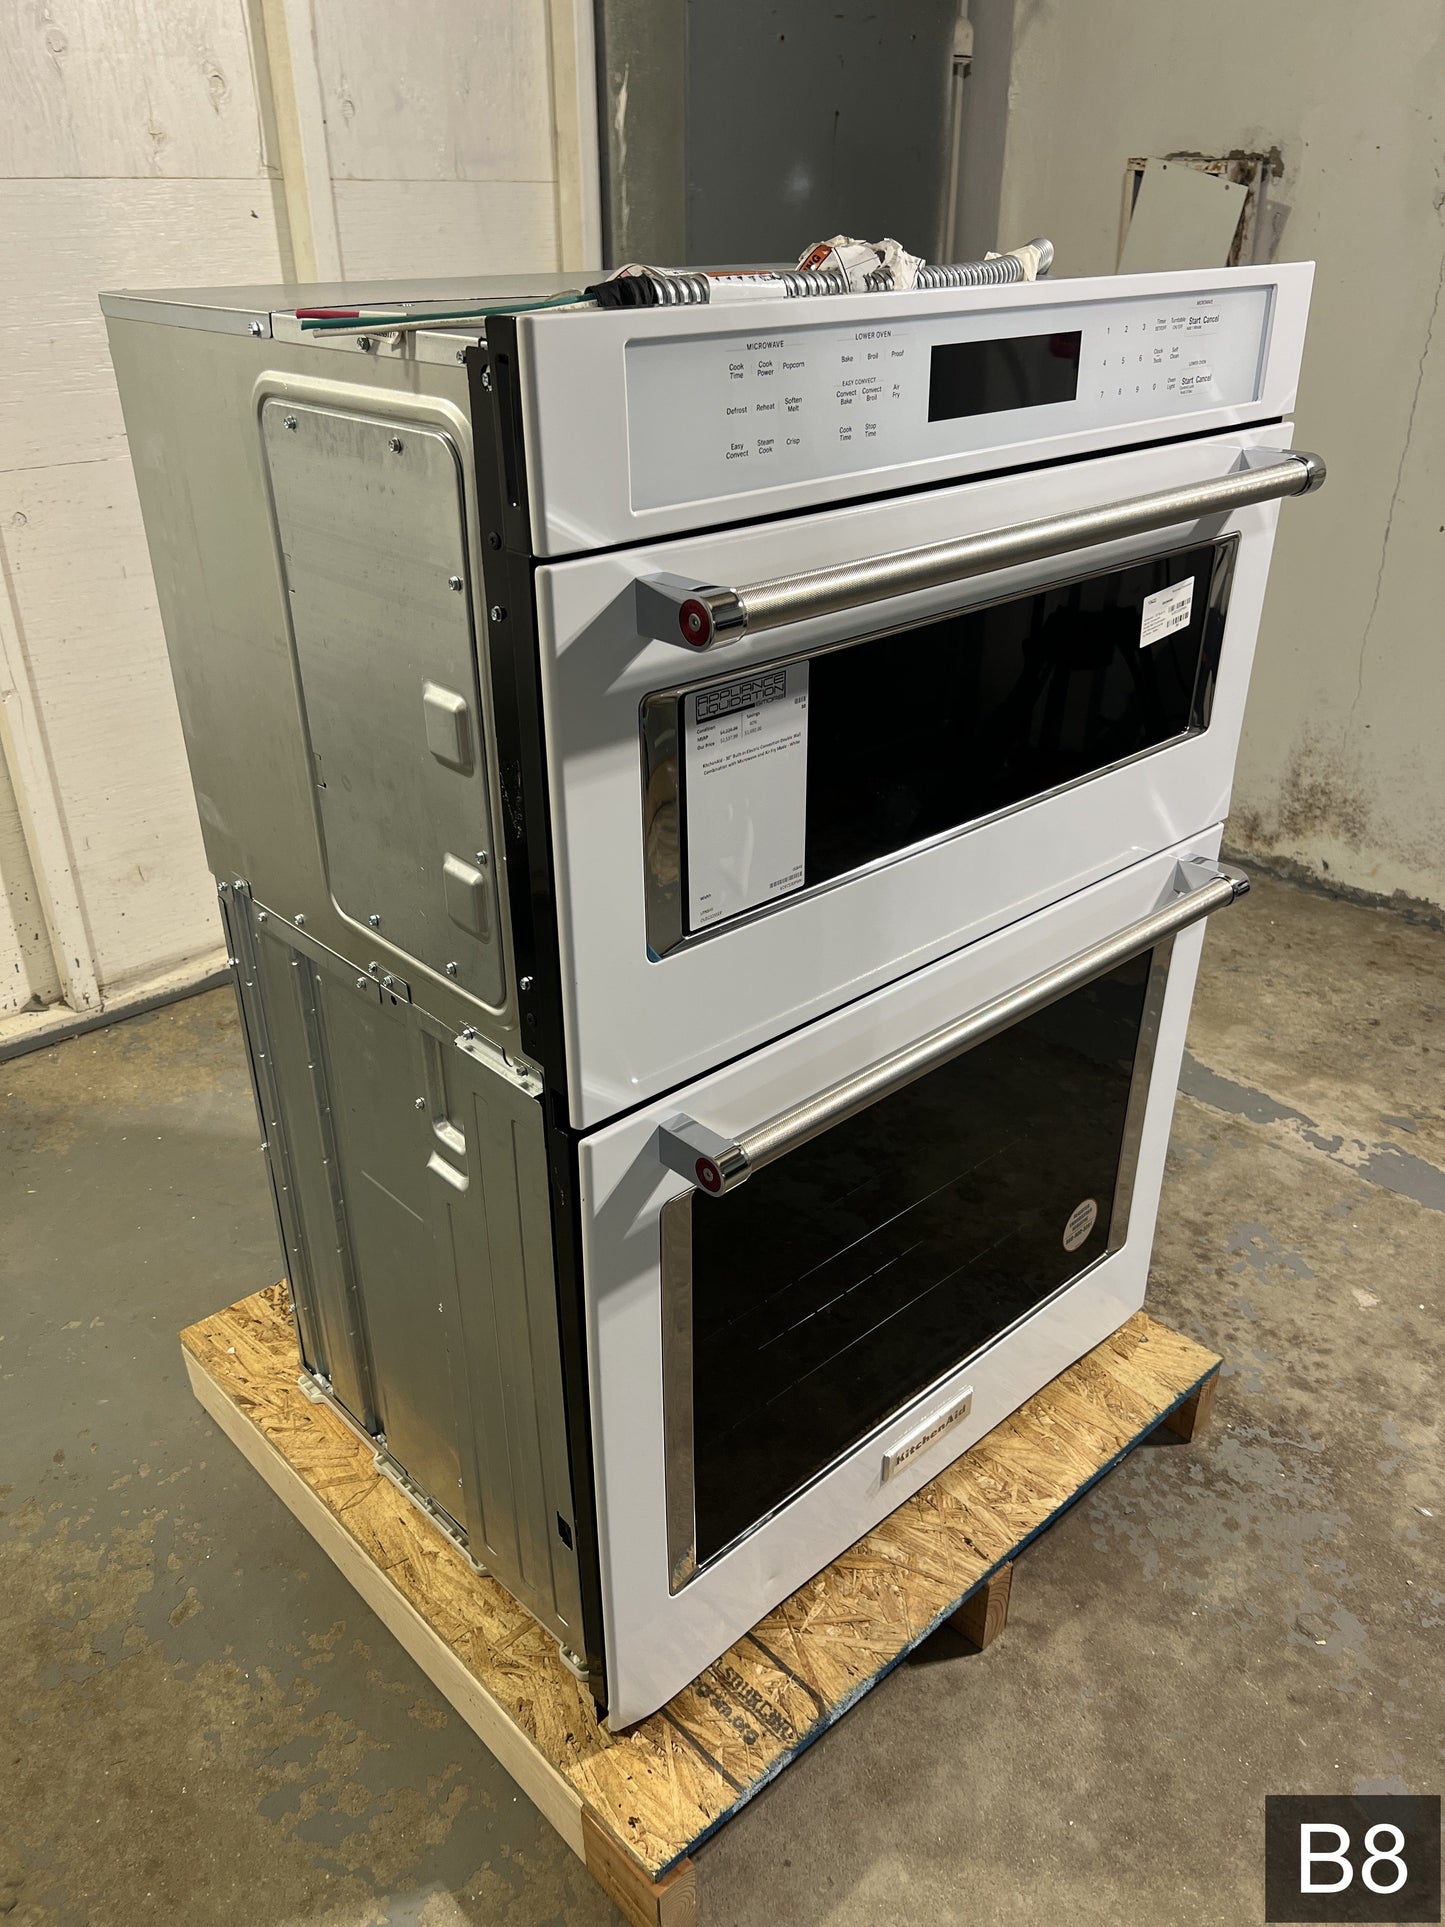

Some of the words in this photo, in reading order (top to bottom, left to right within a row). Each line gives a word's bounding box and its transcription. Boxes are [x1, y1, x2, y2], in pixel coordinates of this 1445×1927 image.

[1189, 317, 1201, 325] Start
[1203, 314, 1219, 323] Cancel
[855, 332, 874, 341] LOWER
[875, 330, 891, 338] OVEN
[747, 340, 784, 351] MICROWAVE
[867, 352, 878, 360] Broil
[891, 349, 904, 358] Proof
[841, 354, 853, 362] Bake
[1139, 354, 1142, 362] 6
[729, 363, 744, 371] Cook
[758, 360, 772, 368] Cook
[783, 360, 805, 369] Popcorn
[730, 372, 744, 380] Time
[757, 368, 774, 376] Power
[856, 377, 876, 385] CONVECT
[1182, 377, 1194, 385] Start
[1196, 374, 1212, 383] Cancel
[836, 389, 856, 398] Convect
[862, 386, 882, 394] Convect
[892, 391, 900, 399] Fry
[784, 397, 802, 405] Soften
[840, 397, 853, 405] Bake
[727, 406, 747, 416] Defrost
[756, 402, 775, 412] Reheat
[788, 405, 800, 413] Melt
[839, 425, 852, 434] Cook
[865, 423, 876, 432] Stop
[840, 433, 851, 441] Time
[865, 429, 876, 437] Time
[757, 438, 774, 446] Steam
[786, 436, 800, 446] Crisp
[731, 443, 744, 452] Easy
[759, 446, 772, 454] Cook
[726, 450, 748, 460] Convect
[698, 674, 784, 705] APPLIANCE
[698, 685, 784, 717] LIQUIDATION
[896, 1404, 966, 1465] KitchenAid
